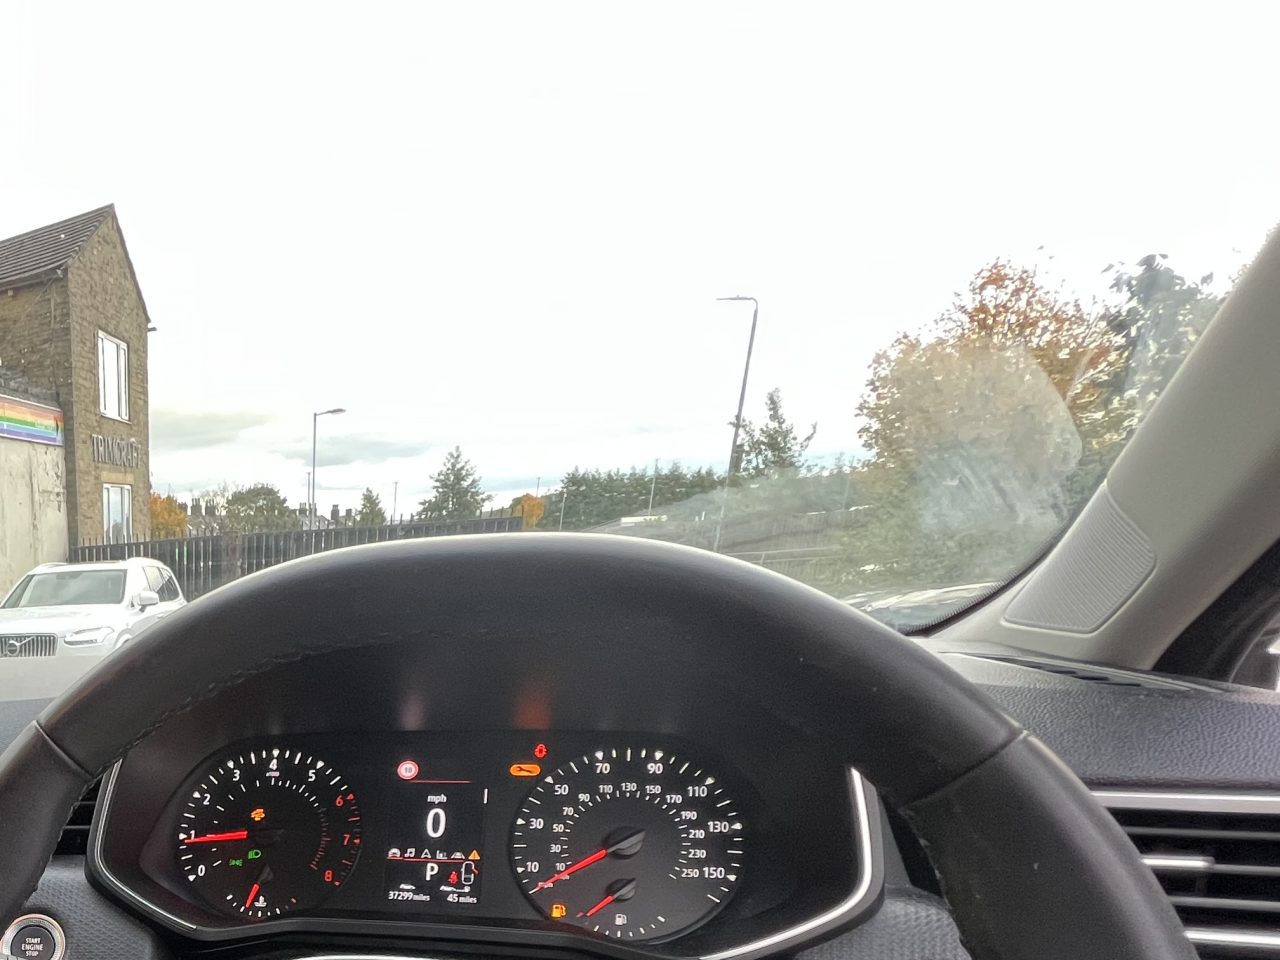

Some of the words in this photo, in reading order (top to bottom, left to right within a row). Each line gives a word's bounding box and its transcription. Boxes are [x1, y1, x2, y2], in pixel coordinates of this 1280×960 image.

[92, 433, 141, 469] TRIMCRAFT
[270, 759, 278, 770] 4
[595, 763, 610, 774] 70
[647, 763, 663, 774] 90
[232, 770, 240, 782] 3
[308, 770, 316, 782] 5
[554, 784, 569, 795] 50
[598, 784, 613, 793] 110
[621, 783, 637, 791] 130
[645, 785, 661, 794] 150
[687, 786, 708, 797] 110
[202, 794, 211, 805] 2
[335, 795, 343, 807] 6
[427, 794, 447, 804] mph
[578, 793, 590, 802] 90
[665, 795, 682, 804] 170
[562, 807, 574, 816] 70
[681, 811, 697, 820] 190
[426, 807, 446, 838] 0
[529, 818, 544, 829] 30
[552, 823, 564, 833] 50
[707, 821, 729, 833] 130
[343, 834, 350, 845] 7
[688, 829, 705, 839] 210
[550, 844, 561, 853] 30
[688, 849, 706, 858] 230
[198, 864, 206, 876] 0
[426, 862, 439, 881] P
[526, 861, 539, 873] 10
[555, 862, 566, 871] 10
[324, 870, 332, 882] 8
[681, 868, 700, 878] 250
[702, 867, 725, 879] 150
[447, 894, 459, 903] 45
